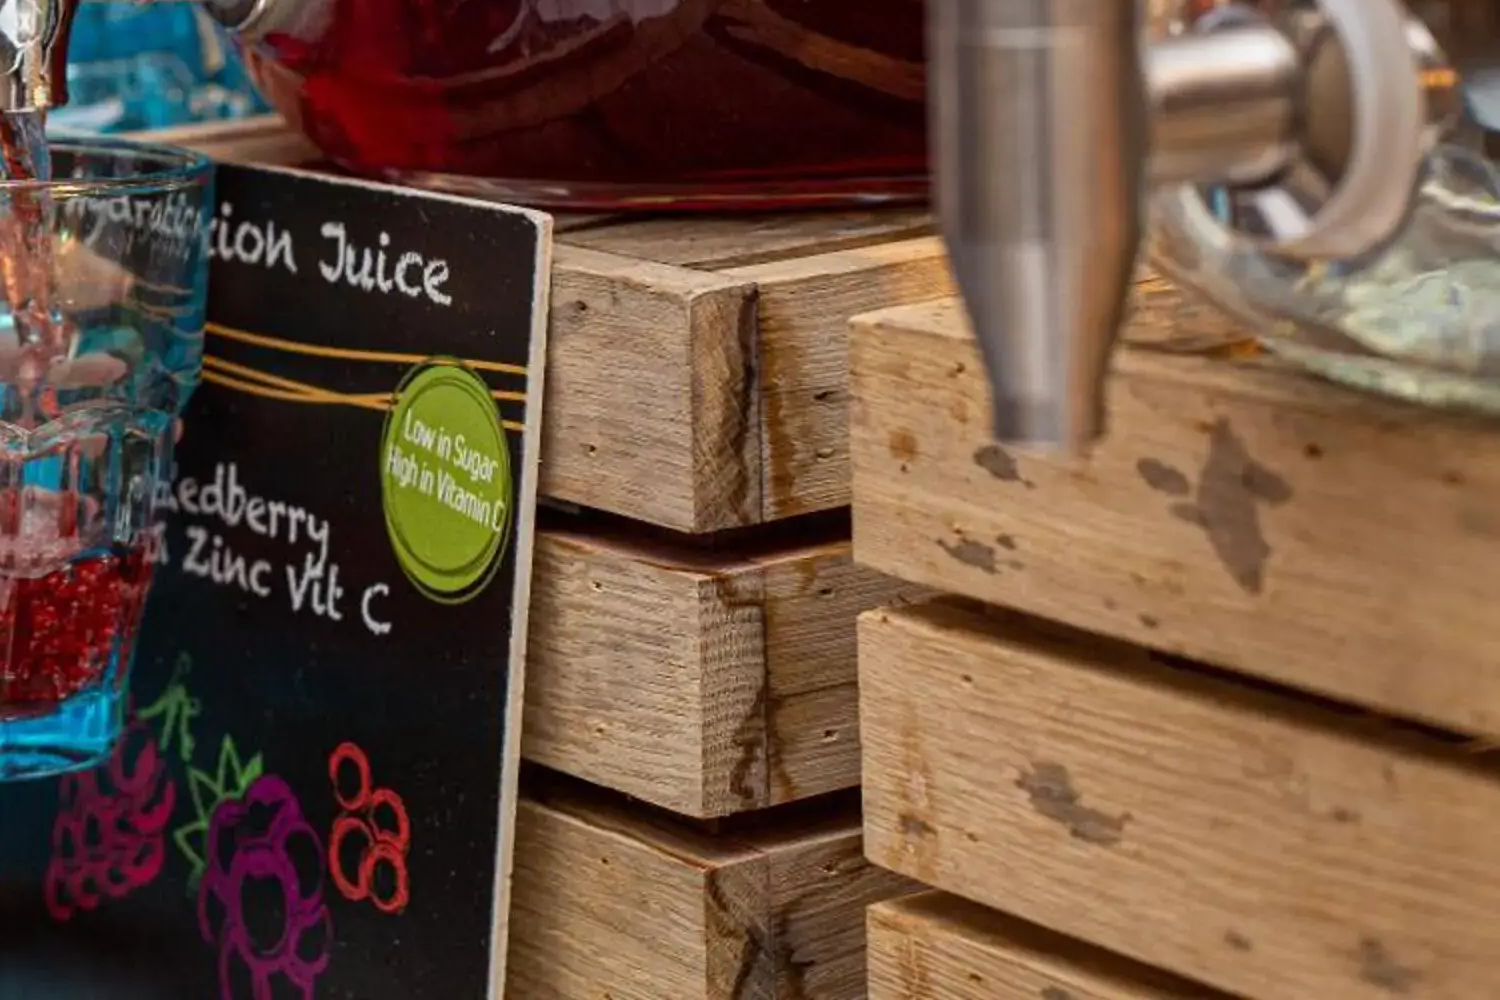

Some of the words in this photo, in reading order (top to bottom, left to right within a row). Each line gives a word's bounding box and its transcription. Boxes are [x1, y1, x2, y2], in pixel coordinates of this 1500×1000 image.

[319, 222, 452, 304] Juice
[386, 443, 418, 487] High
[419, 462, 434, 495] in
[437, 467, 491, 527] Vitamin
[492, 500, 505, 532] C
[404, 408, 435, 450] Low
[438, 426, 451, 461] in
[453, 434, 499, 482] Sugar
[182, 526, 272, 598] Zinc
[285, 552, 344, 621] Vit
[360, 582, 392, 635] C
